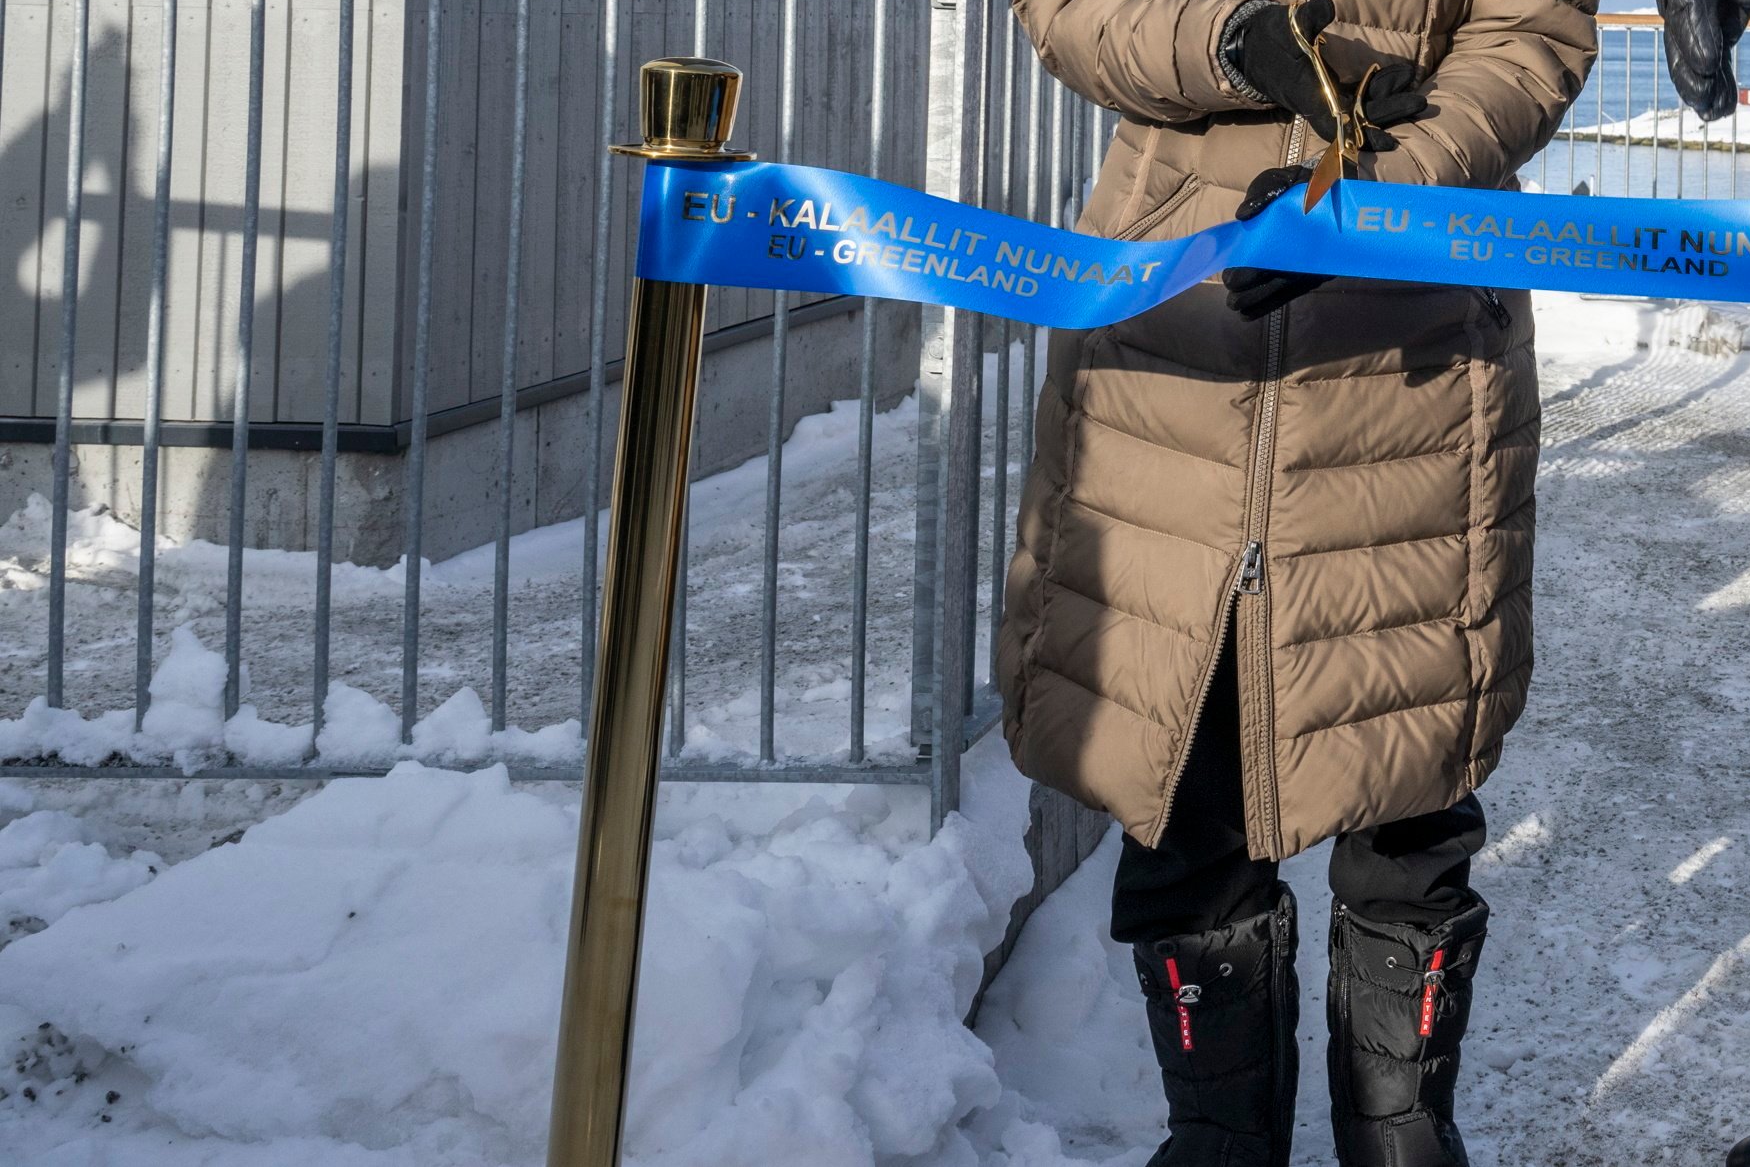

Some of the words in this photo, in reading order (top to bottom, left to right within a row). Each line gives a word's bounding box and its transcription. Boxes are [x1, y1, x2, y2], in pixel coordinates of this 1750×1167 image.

[682, 191, 736, 224] EU
[769, 198, 987, 256] KALAALLIT
[995, 241, 1162, 285] NUNAAT
[1356, 207, 1411, 233] EU
[1447, 212, 1667, 250] KALAALLIT
[768, 234, 807, 260] EU
[833, 239, 1039, 298] GREENLAND
[1449, 239, 1493, 262] EU
[1524, 245, 1729, 277] GREENLAND
